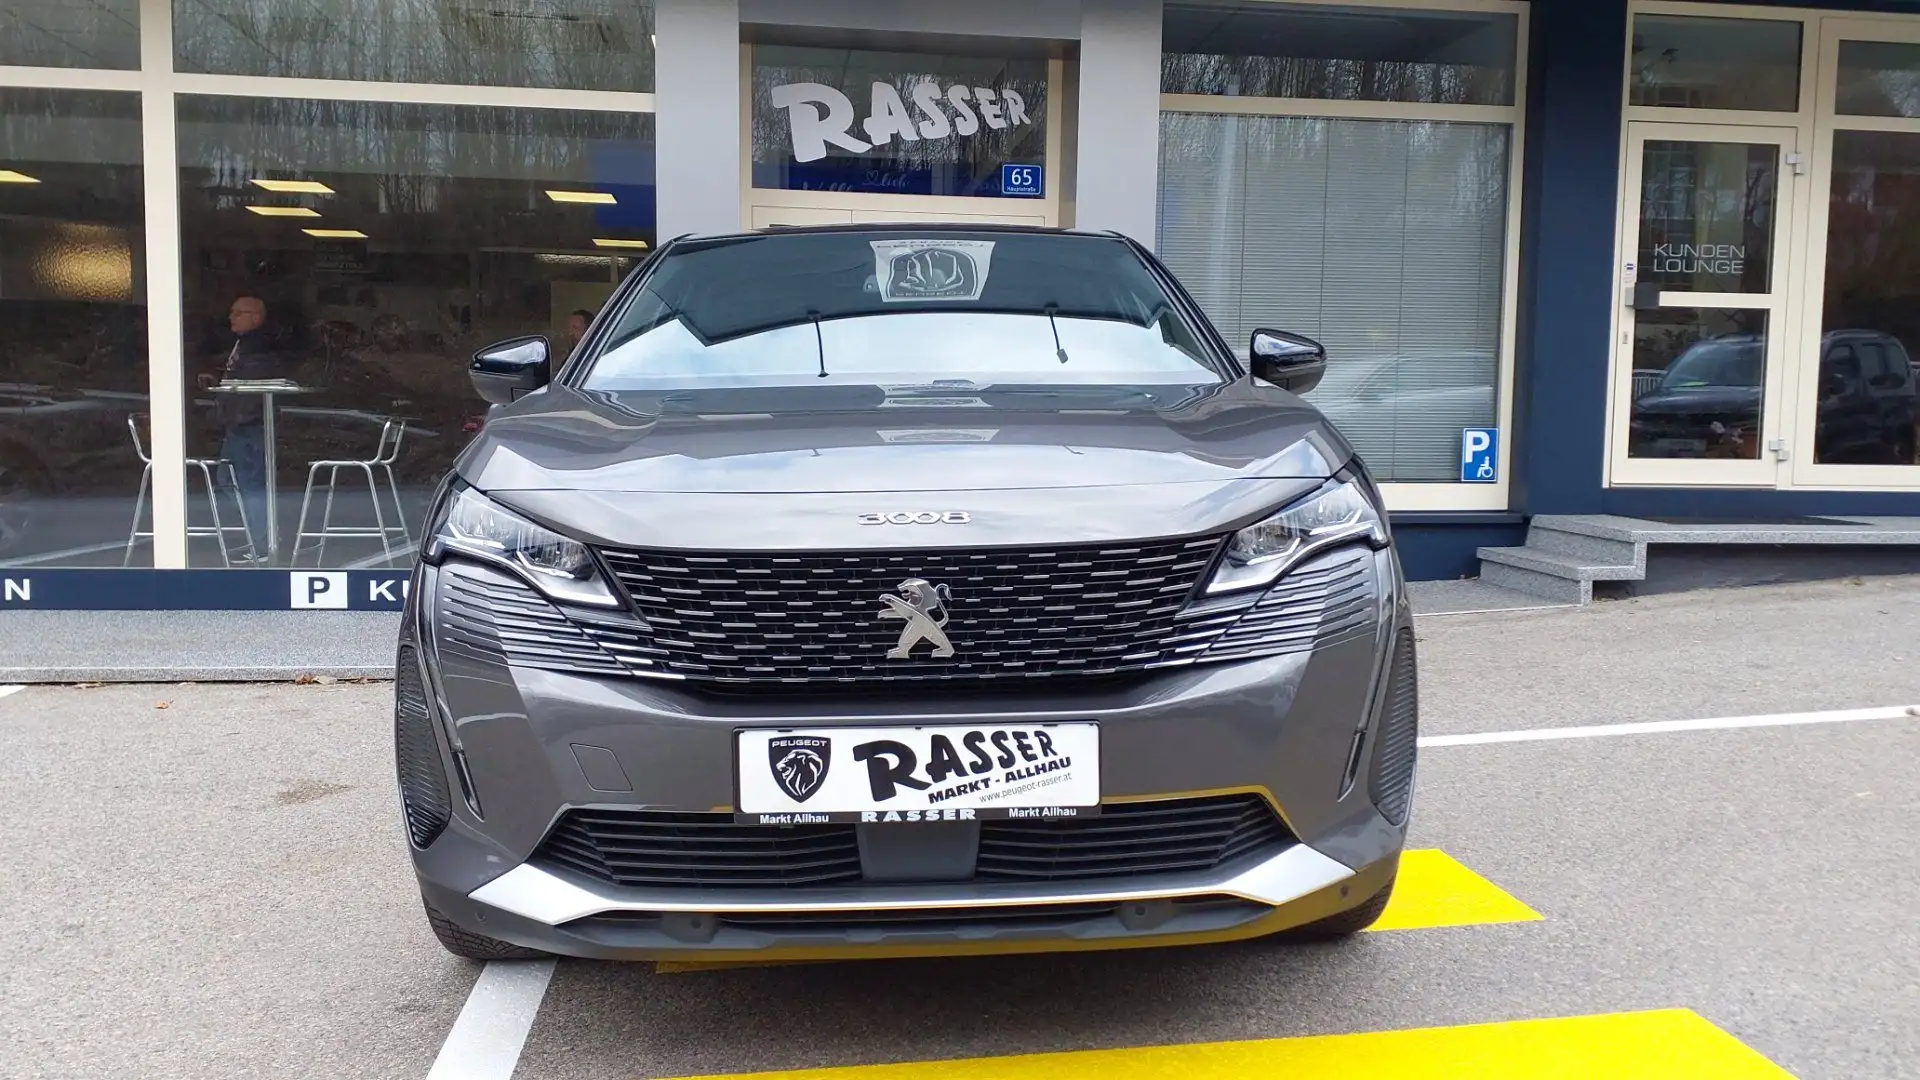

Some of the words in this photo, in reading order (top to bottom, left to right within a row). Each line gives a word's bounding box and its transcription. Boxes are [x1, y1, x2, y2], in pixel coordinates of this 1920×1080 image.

[771, 82, 1031, 162] RASSER
[1011, 168, 1032, 185] 65
[1654, 243, 1745, 258] KUNDEN
[1653, 259, 1744, 274] LOUNGE
[1465, 431, 1490, 463] P
[858, 511, 972, 525] 3008
[308, 576, 331, 604] P
[771, 739, 828, 747] PEUGEOT
[852, 730, 1058, 802] RASSER
[927, 777, 992, 804] MARKT
[1004, 756, 1072, 783] ALLHAU
[978, 772, 1073, 803] www.peugeot-rasser.at
[759, 815, 791, 824] Markt
[794, 813, 830, 823] Allhau
[861, 809, 977, 822] RASSER
[1008, 807, 1040, 818] Markt
[1042, 806, 1077, 817] Allhau
